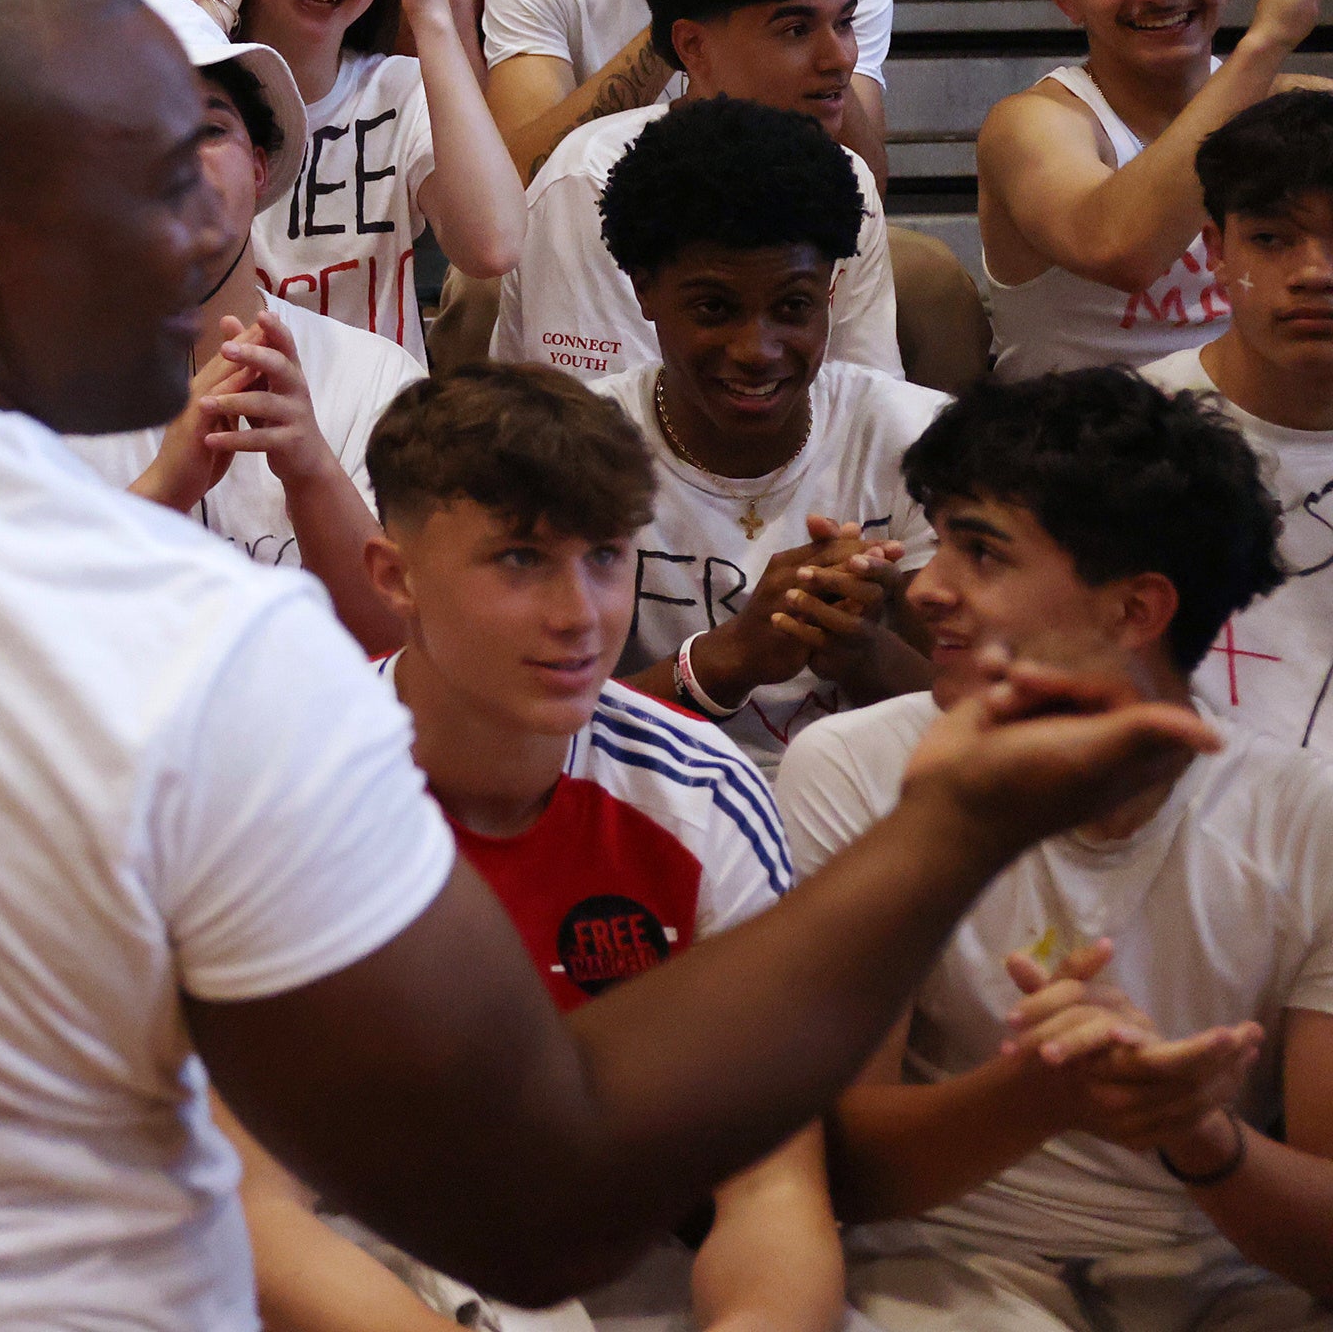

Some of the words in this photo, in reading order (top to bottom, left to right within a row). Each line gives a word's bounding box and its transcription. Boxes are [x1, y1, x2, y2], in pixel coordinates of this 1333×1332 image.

[542, 332, 622, 354] CONNECT
[549, 351, 608, 372] YOUTH
[573, 913, 651, 956] FREE
